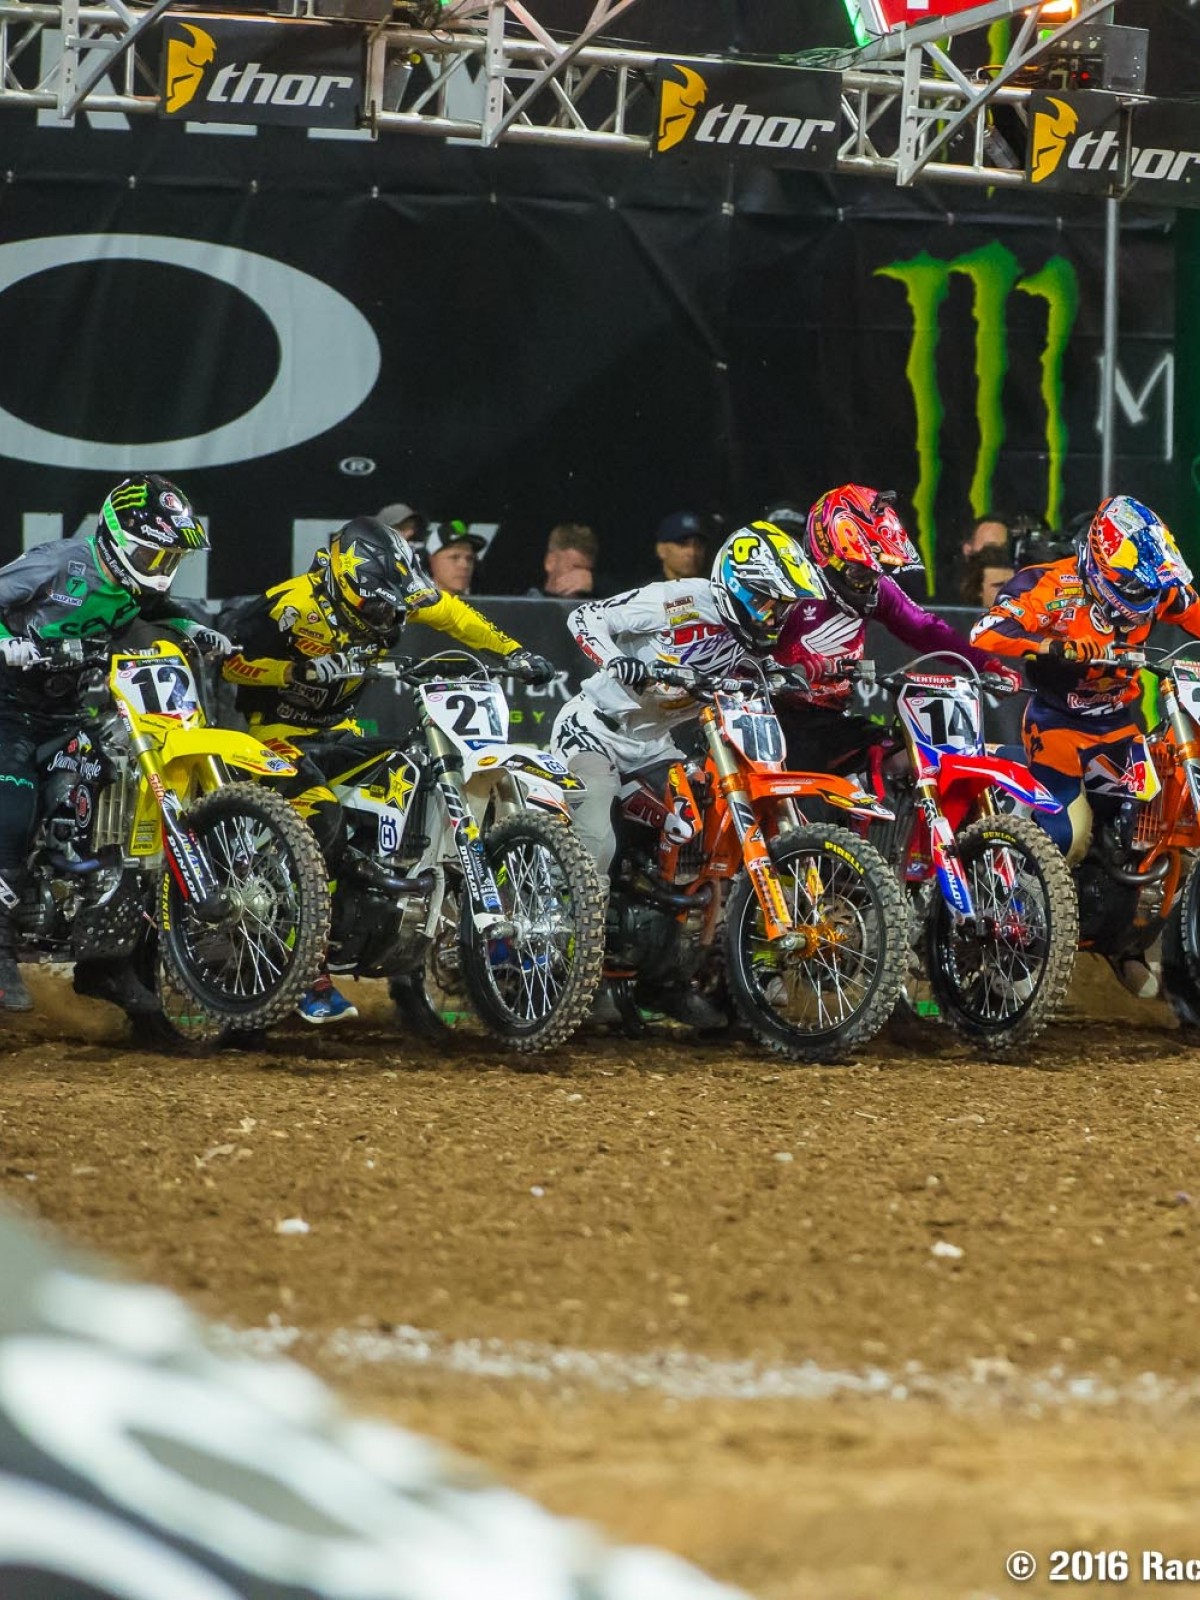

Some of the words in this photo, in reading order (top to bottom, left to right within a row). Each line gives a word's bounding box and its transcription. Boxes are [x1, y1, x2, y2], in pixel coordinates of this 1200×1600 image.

[207, 63, 353, 108] thor
[694, 103, 835, 151] thor
[348, 644, 378, 655] ATLAS
[131, 667, 197, 712] 12
[446, 695, 503, 737] 21
[733, 714, 783, 762] 10
[919, 699, 977, 746] 14
[168, 835, 200, 903] DUNLOP
[459, 845, 481, 901] DUNLOP
[824, 840, 865, 875] PIRELLI
[163, 873, 171, 931] DUNLOP
